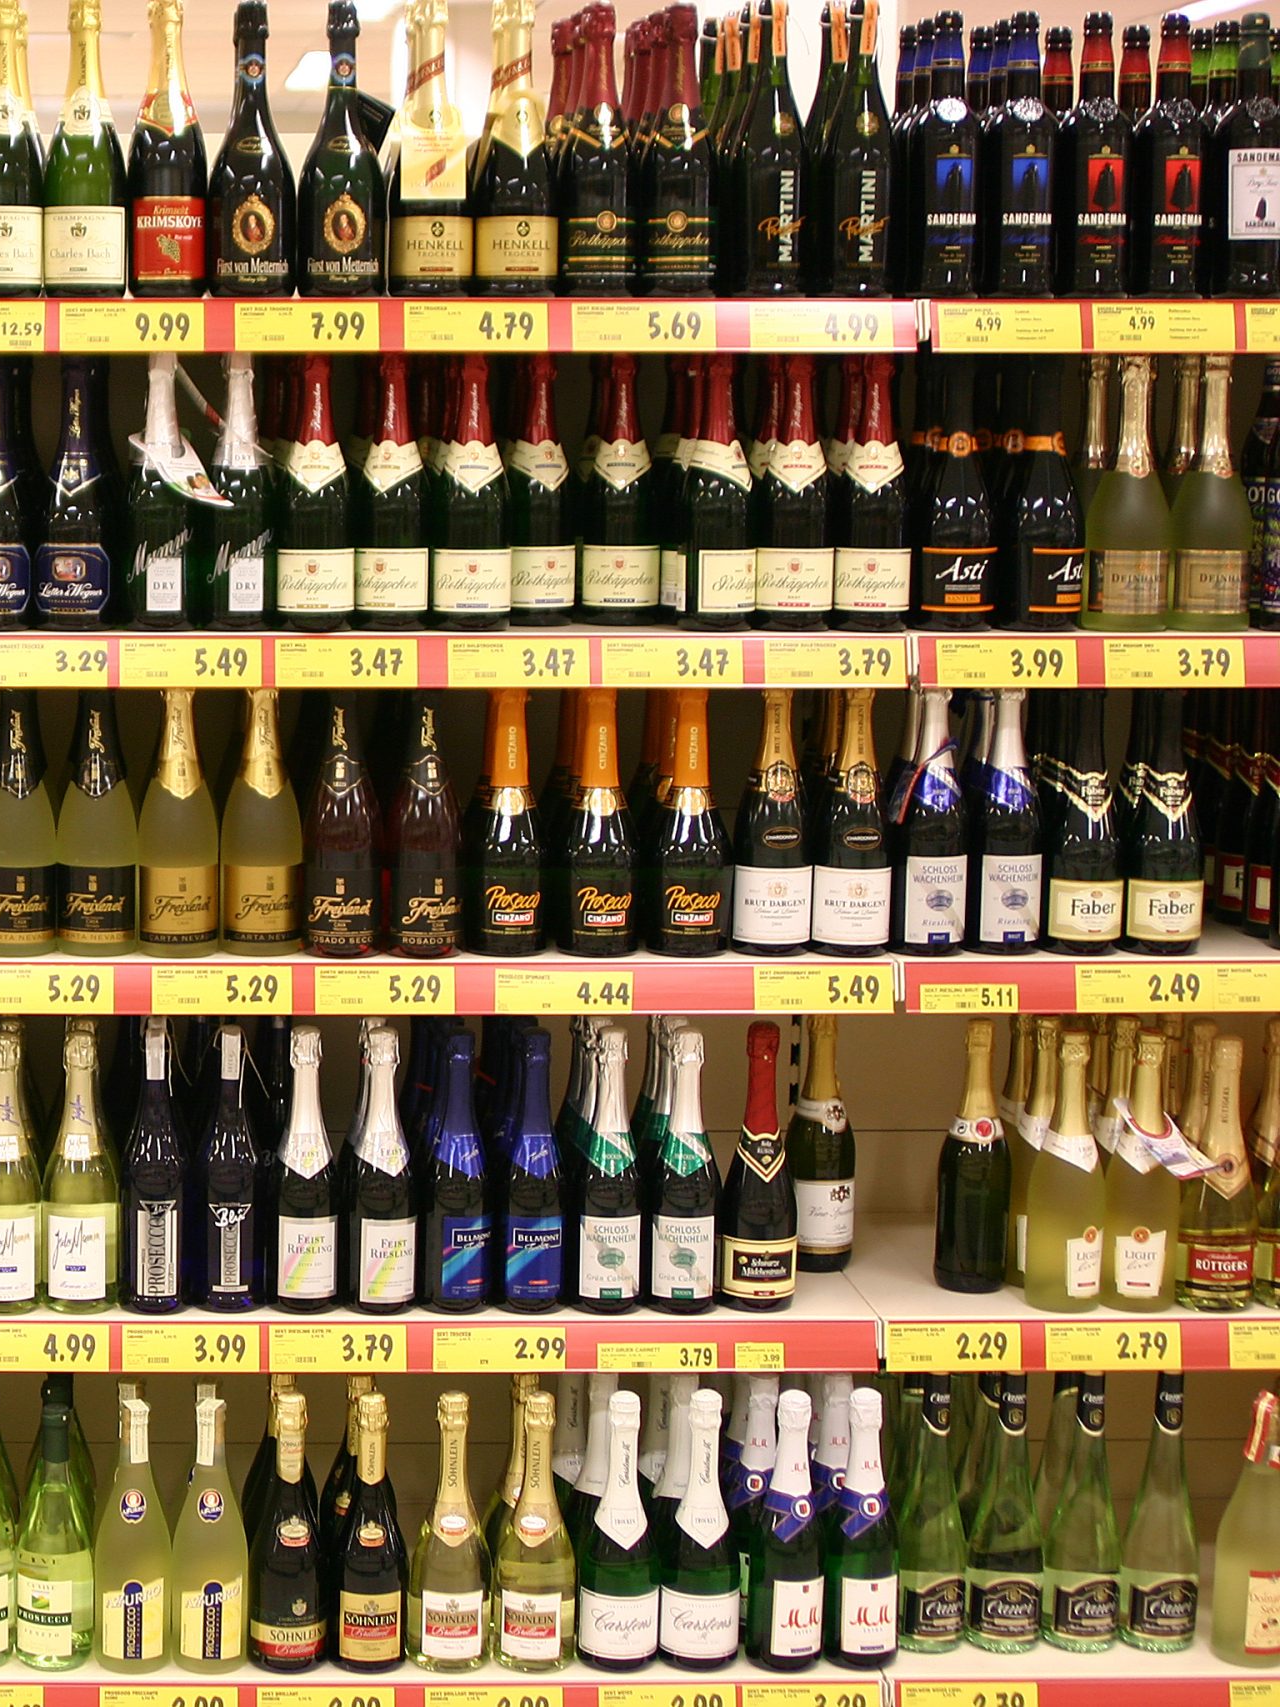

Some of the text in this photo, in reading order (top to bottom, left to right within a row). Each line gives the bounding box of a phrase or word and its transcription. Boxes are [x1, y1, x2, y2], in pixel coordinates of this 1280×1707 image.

[1237, 152, 1280, 163] SANDEMA
[778, 170, 795, 263] MARTINI
[858, 170, 876, 263] MARTINI
[927, 214, 976, 225] SANDEMAN
[1003, 214, 1051, 225] SANDEMAN
[1078, 214, 1126, 225] SANDEMAN
[49, 248, 84, 259] Charles
[407, 241, 464, 251] HENKELL
[493, 241, 550, 251] HENKELL
[234, 262, 249, 273] von
[325, 262, 340, 272] von
[1, 323, 42, 335] 12.59
[136, 313, 190, 341] 9.99
[311, 312, 365, 341] 7.99
[479, 311, 534, 340] 4.79
[648, 311, 702, 340] 5.69
[825, 313, 878, 341] 4.99
[976, 317, 1001, 330] 4.99
[1129, 316, 1155, 330] 4.99
[935, 557, 987, 581] Asti
[153, 582, 174, 590] DRY
[236, 582, 257, 590] DRY
[55, 649, 108, 672] 3.29
[195, 648, 247, 677] 5.49
[350, 648, 403, 677] 3.47
[523, 648, 575, 677] 3.47
[677, 648, 728, 677] 3.47
[838, 648, 891, 676] 3.79
[1010, 649, 1063, 677] 3.99
[1178, 648, 1230, 677] 3.79
[922, 865, 957, 874] SCHLOSS
[486, 886, 540, 912] Prosecco
[578, 886, 632, 912] Prosecco
[745, 899, 770, 907] BRUT
[825, 899, 847, 907] BRUT
[1071, 899, 1116, 916] Faber
[1149, 899, 1195, 916] Faber
[496, 913, 531, 923] CINZANO
[587, 914, 623, 924] CINZANO
[675, 913, 711, 923] CINZANO
[48, 975, 100, 1002] 5.29
[225, 974, 278, 1002] 5.29
[389, 975, 441, 1002] 5.29
[578, 982, 629, 1005] 4.44
[828, 975, 880, 1003] 5.49
[981, 988, 1013, 1006] 5.11
[1149, 974, 1200, 1002] 2.49
[457, 1231, 491, 1243] BELMONT
[517, 1232, 559, 1243] BELMONT
[593, 1225, 629, 1234] SCHLOSS
[665, 1224, 701, 1234] SCHLOSS
[297, 1234, 325, 1243] FEIST
[381, 1239, 407, 1249] FEIST
[287, 1245, 333, 1255] RIESLING
[1124, 1250, 1157, 1261] LIGHT
[1195, 1259, 1248, 1272] RÜTTGERS
[44, 1334, 96, 1362] 4.99
[195, 1334, 245, 1362] 3.99
[342, 1334, 393, 1363] 3.79
[515, 1338, 565, 1360] 2.99
[957, 1333, 1007, 1360] 2.29
[1117, 1332, 1167, 1359] 2.79
[680, 1348, 712, 1367] 3.79
[18, 1607, 69, 1623] PROSECCO
[127, 1607, 136, 1657] PROSECCO
